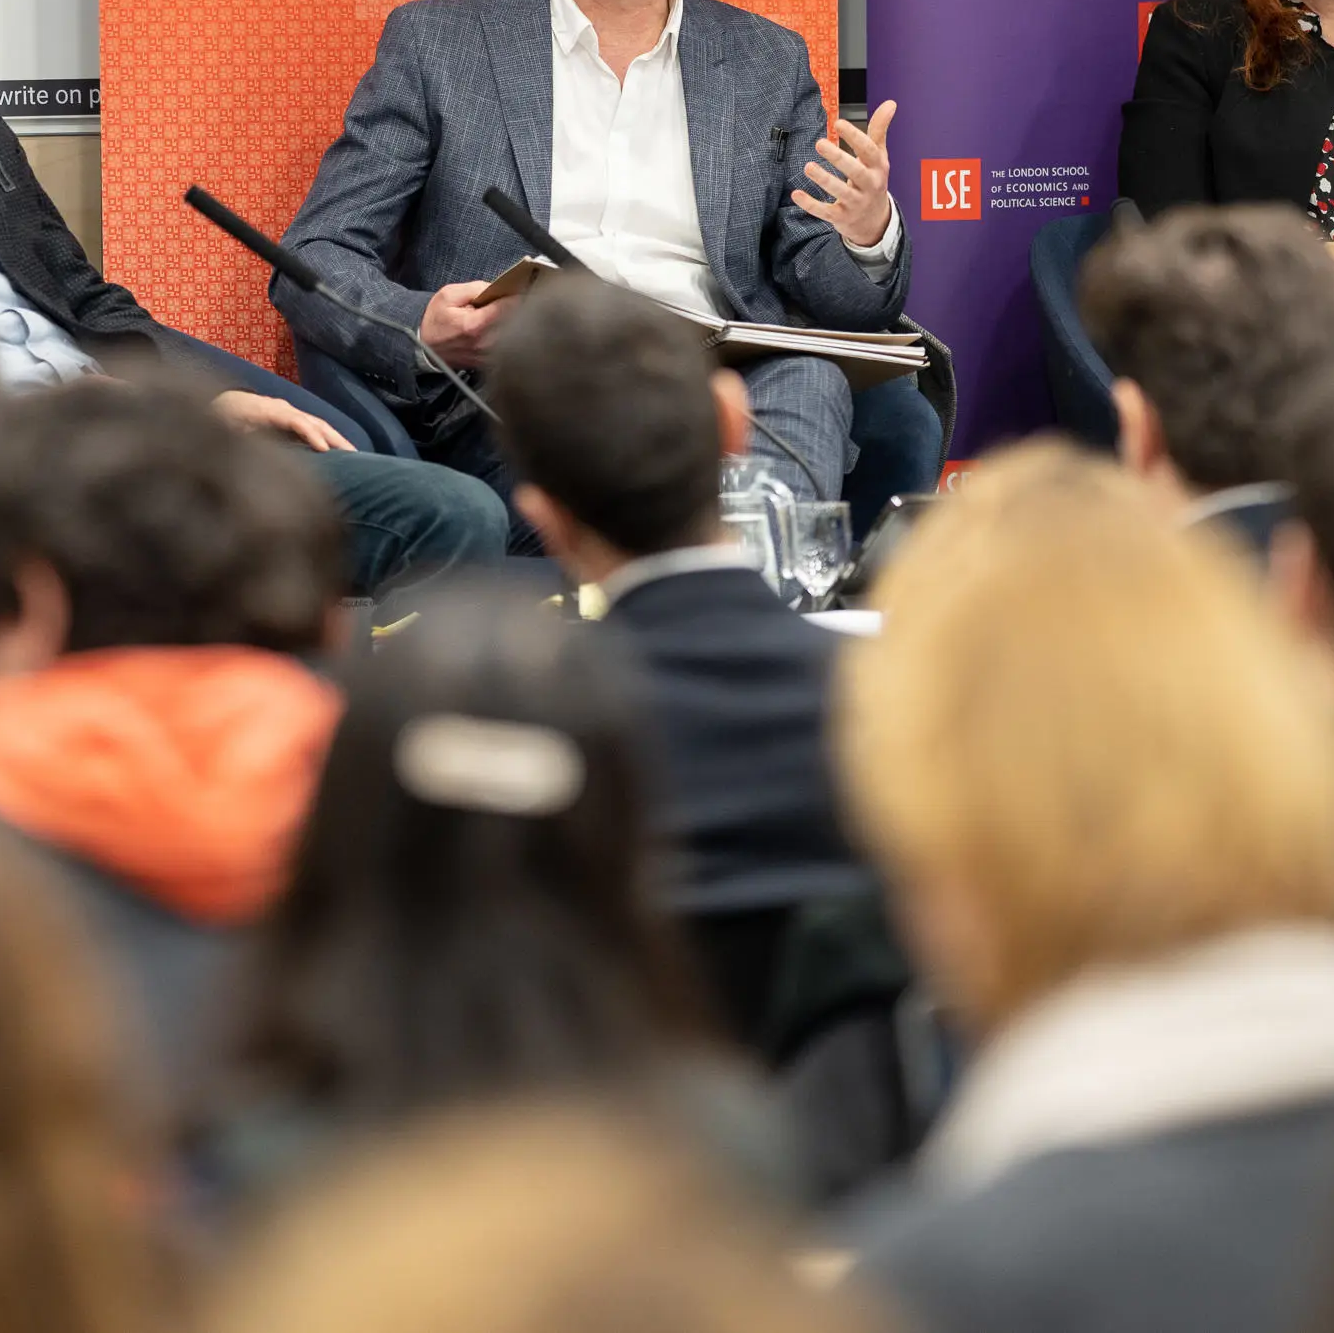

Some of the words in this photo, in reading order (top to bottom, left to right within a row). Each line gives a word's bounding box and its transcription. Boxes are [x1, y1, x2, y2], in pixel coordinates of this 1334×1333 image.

[55, 88, 82, 105] on
[990, 170, 1006, 178] THE
[1008, 167, 1050, 179] LONDON
[1051, 166, 1090, 178] SCHOOL
[931, 169, 971, 210] LSE
[990, 185, 1002, 194] OF
[1006, 181, 1068, 194] ECONOMICS
[1071, 183, 1090, 192] AND
[990, 197, 1038, 209] POLITICAL
[1038, 196, 1076, 208] SCIENCE
